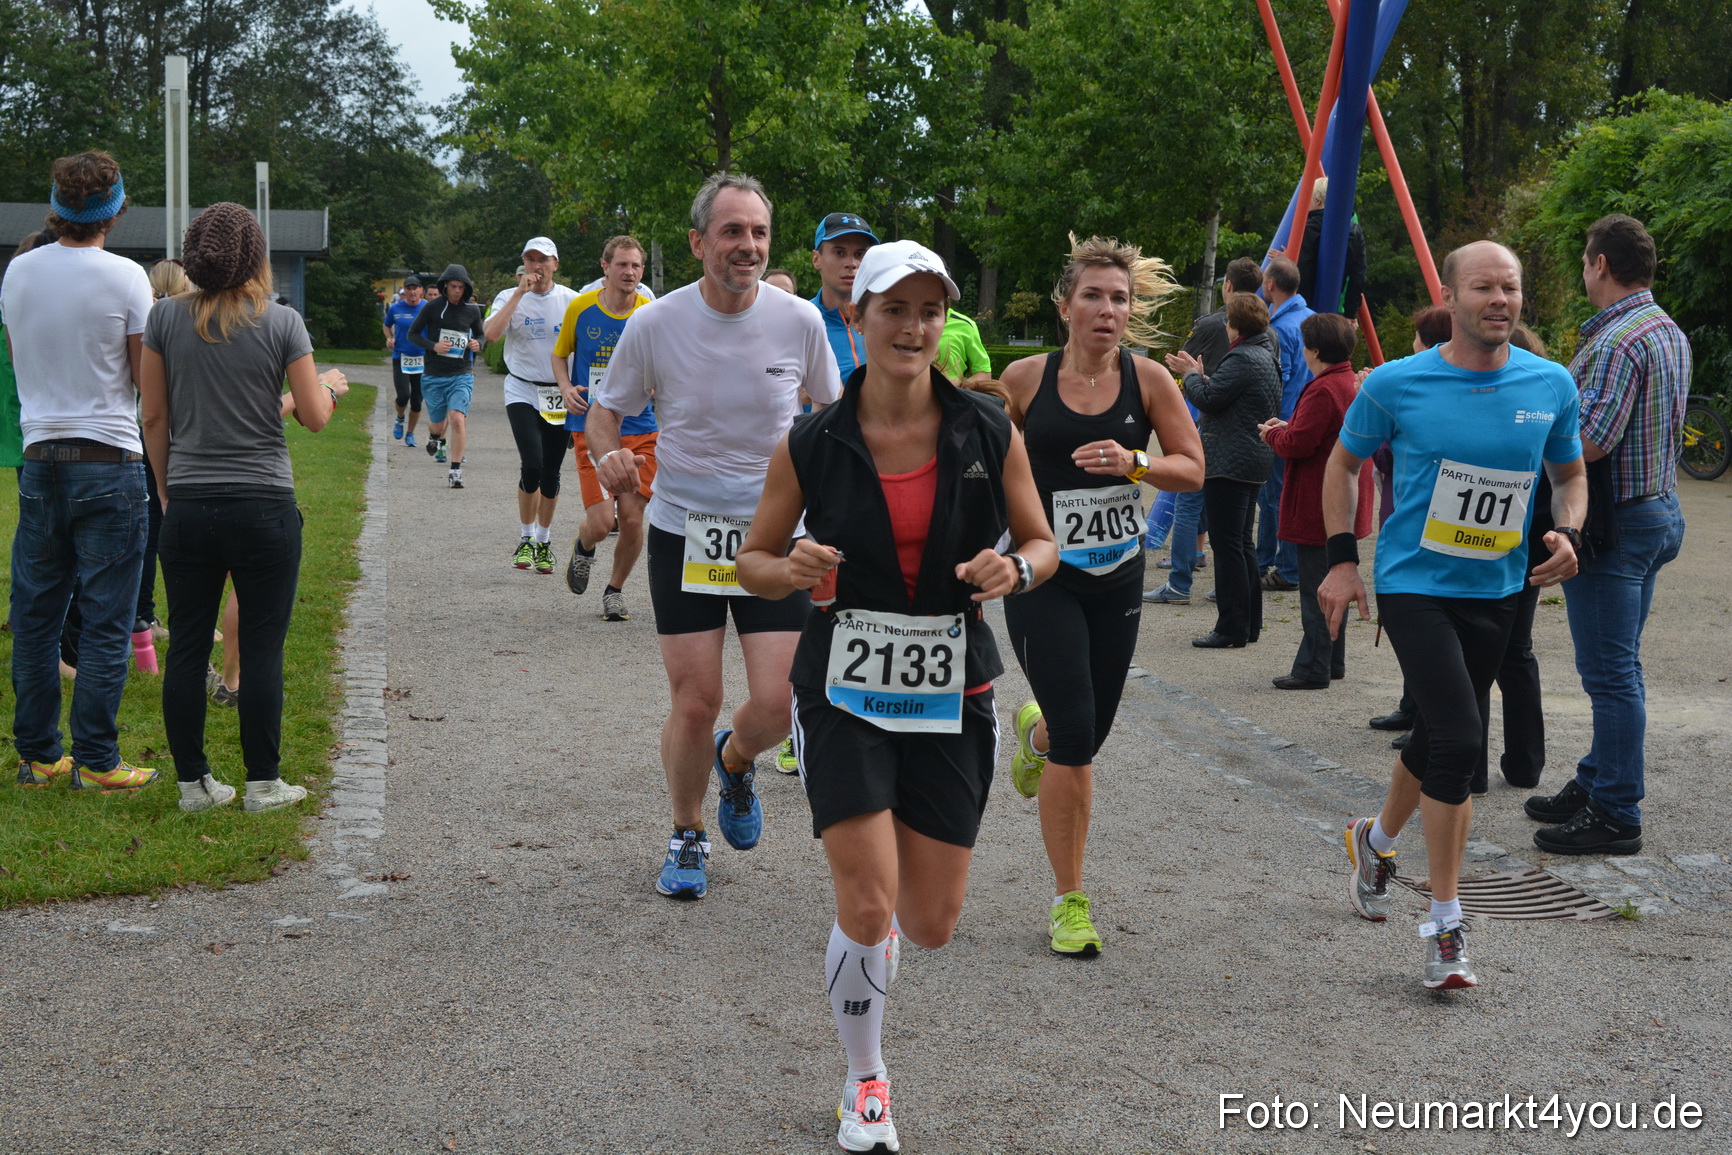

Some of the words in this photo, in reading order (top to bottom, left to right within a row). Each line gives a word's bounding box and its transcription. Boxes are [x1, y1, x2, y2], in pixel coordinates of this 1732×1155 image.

[546, 395, 566, 410] 32
[963, 471, 989, 479] adidas
[1441, 468, 1475, 484] PARTL
[1478, 477, 1521, 489] Neumarkt
[1055, 498, 1088, 509] PARTL
[1090, 493, 1130, 506] Neumarkt
[1457, 488, 1514, 526] 101
[688, 513, 720, 524] PARTL
[1065, 504, 1139, 545] 2403
[705, 528, 749, 562] 30
[1454, 530, 1497, 548] Daniel
[839, 620, 881, 634] PARTL
[884, 625, 943, 637] Neumarkt
[842, 638, 953, 688] 2133
[863, 696, 924, 715] Kerstin
